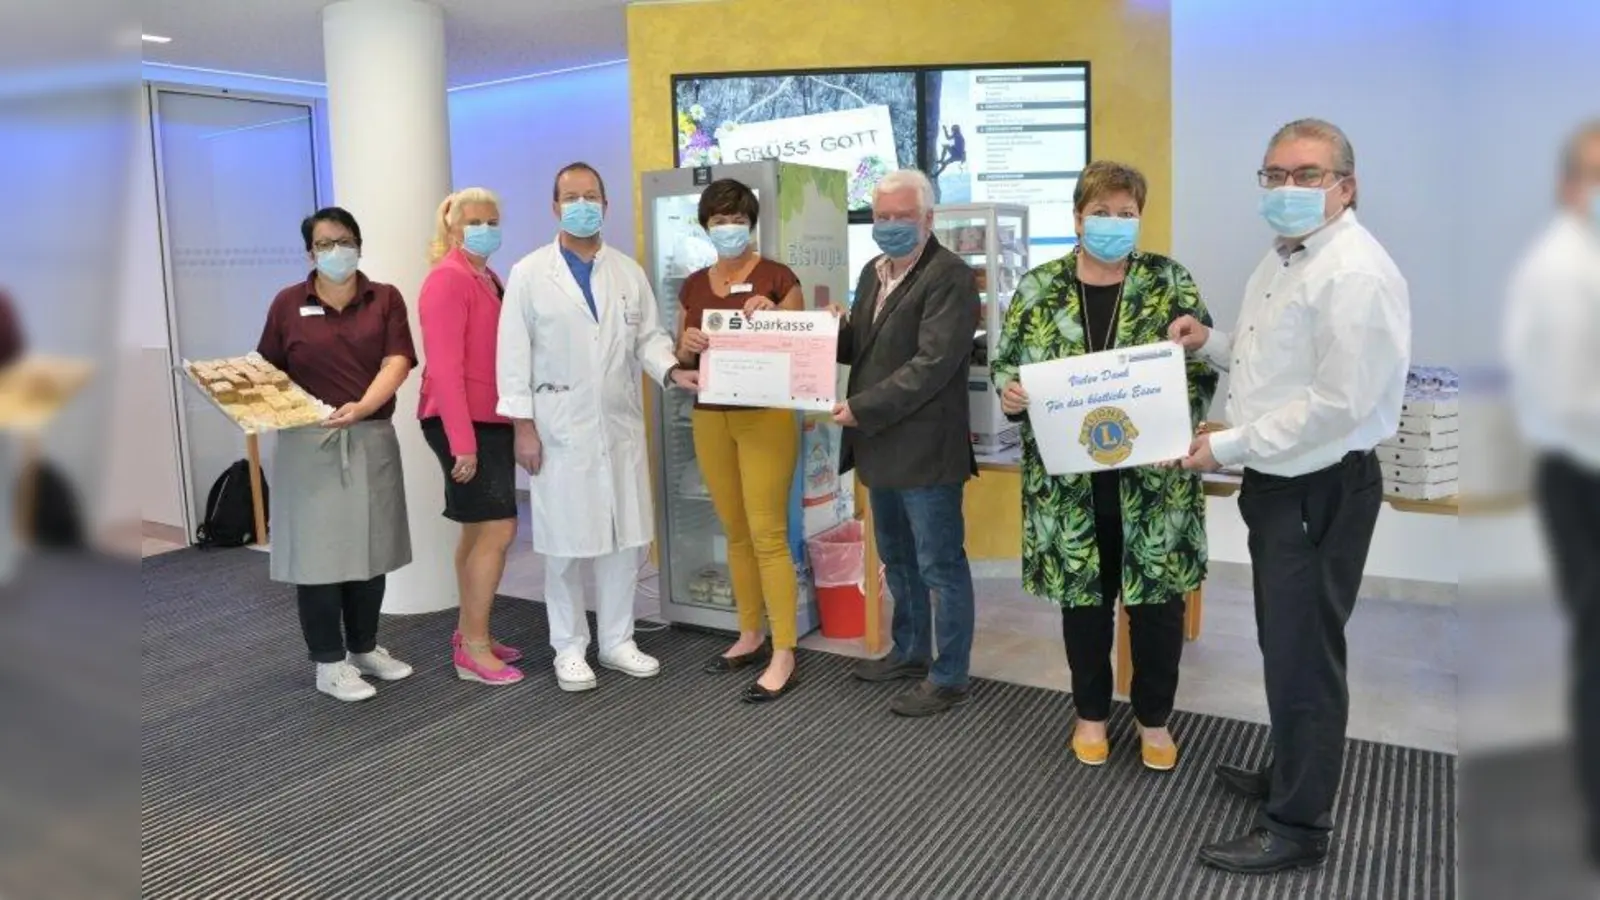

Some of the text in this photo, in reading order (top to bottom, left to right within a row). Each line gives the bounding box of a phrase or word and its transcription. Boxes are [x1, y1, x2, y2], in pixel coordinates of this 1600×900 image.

[820, 130, 878, 151] GOTT
[746, 319, 815, 332] Sparkasse
[1068, 366, 1130, 387] Vielen Dank
[1067, 397, 1084, 408] das
[1132, 384, 1162, 398] Essen
[1100, 425, 1118, 446] L
